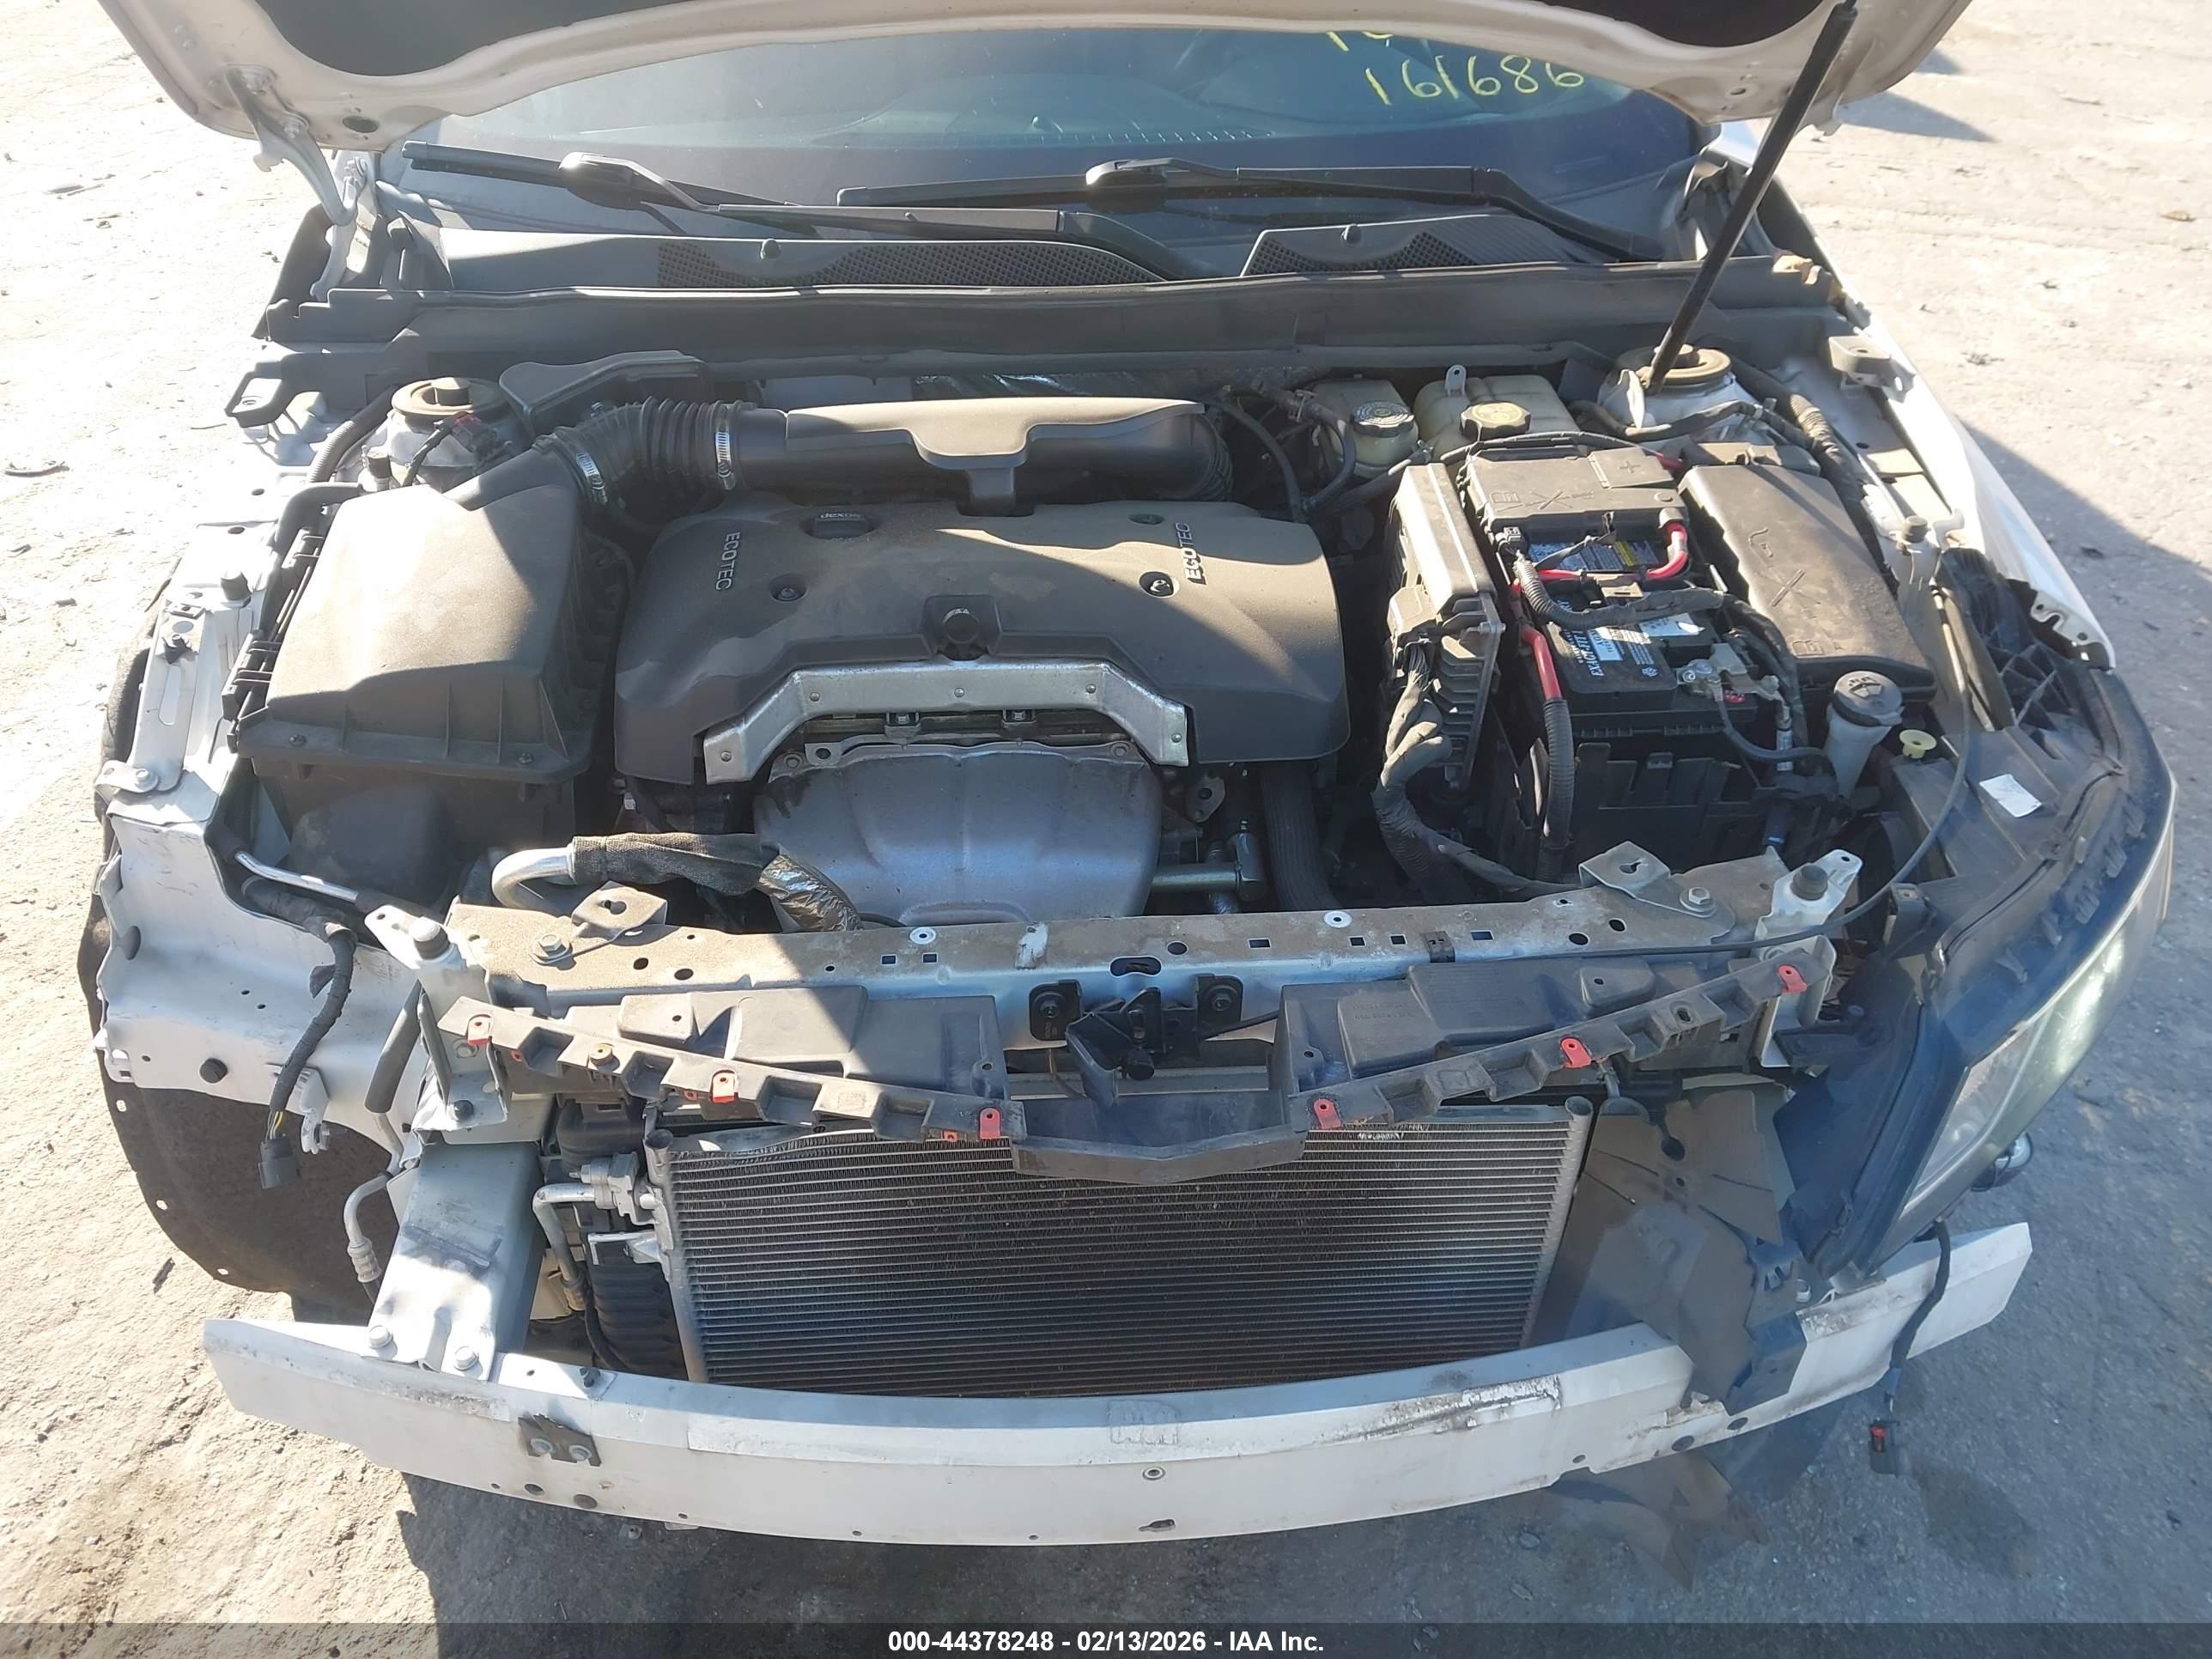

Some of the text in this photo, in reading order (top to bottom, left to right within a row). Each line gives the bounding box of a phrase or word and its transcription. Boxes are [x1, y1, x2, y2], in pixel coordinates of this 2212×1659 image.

[1366, 55, 1584, 105] 161686
[716, 532, 740, 590] ECOTEC
[1176, 522, 1201, 580] ECOTEC
